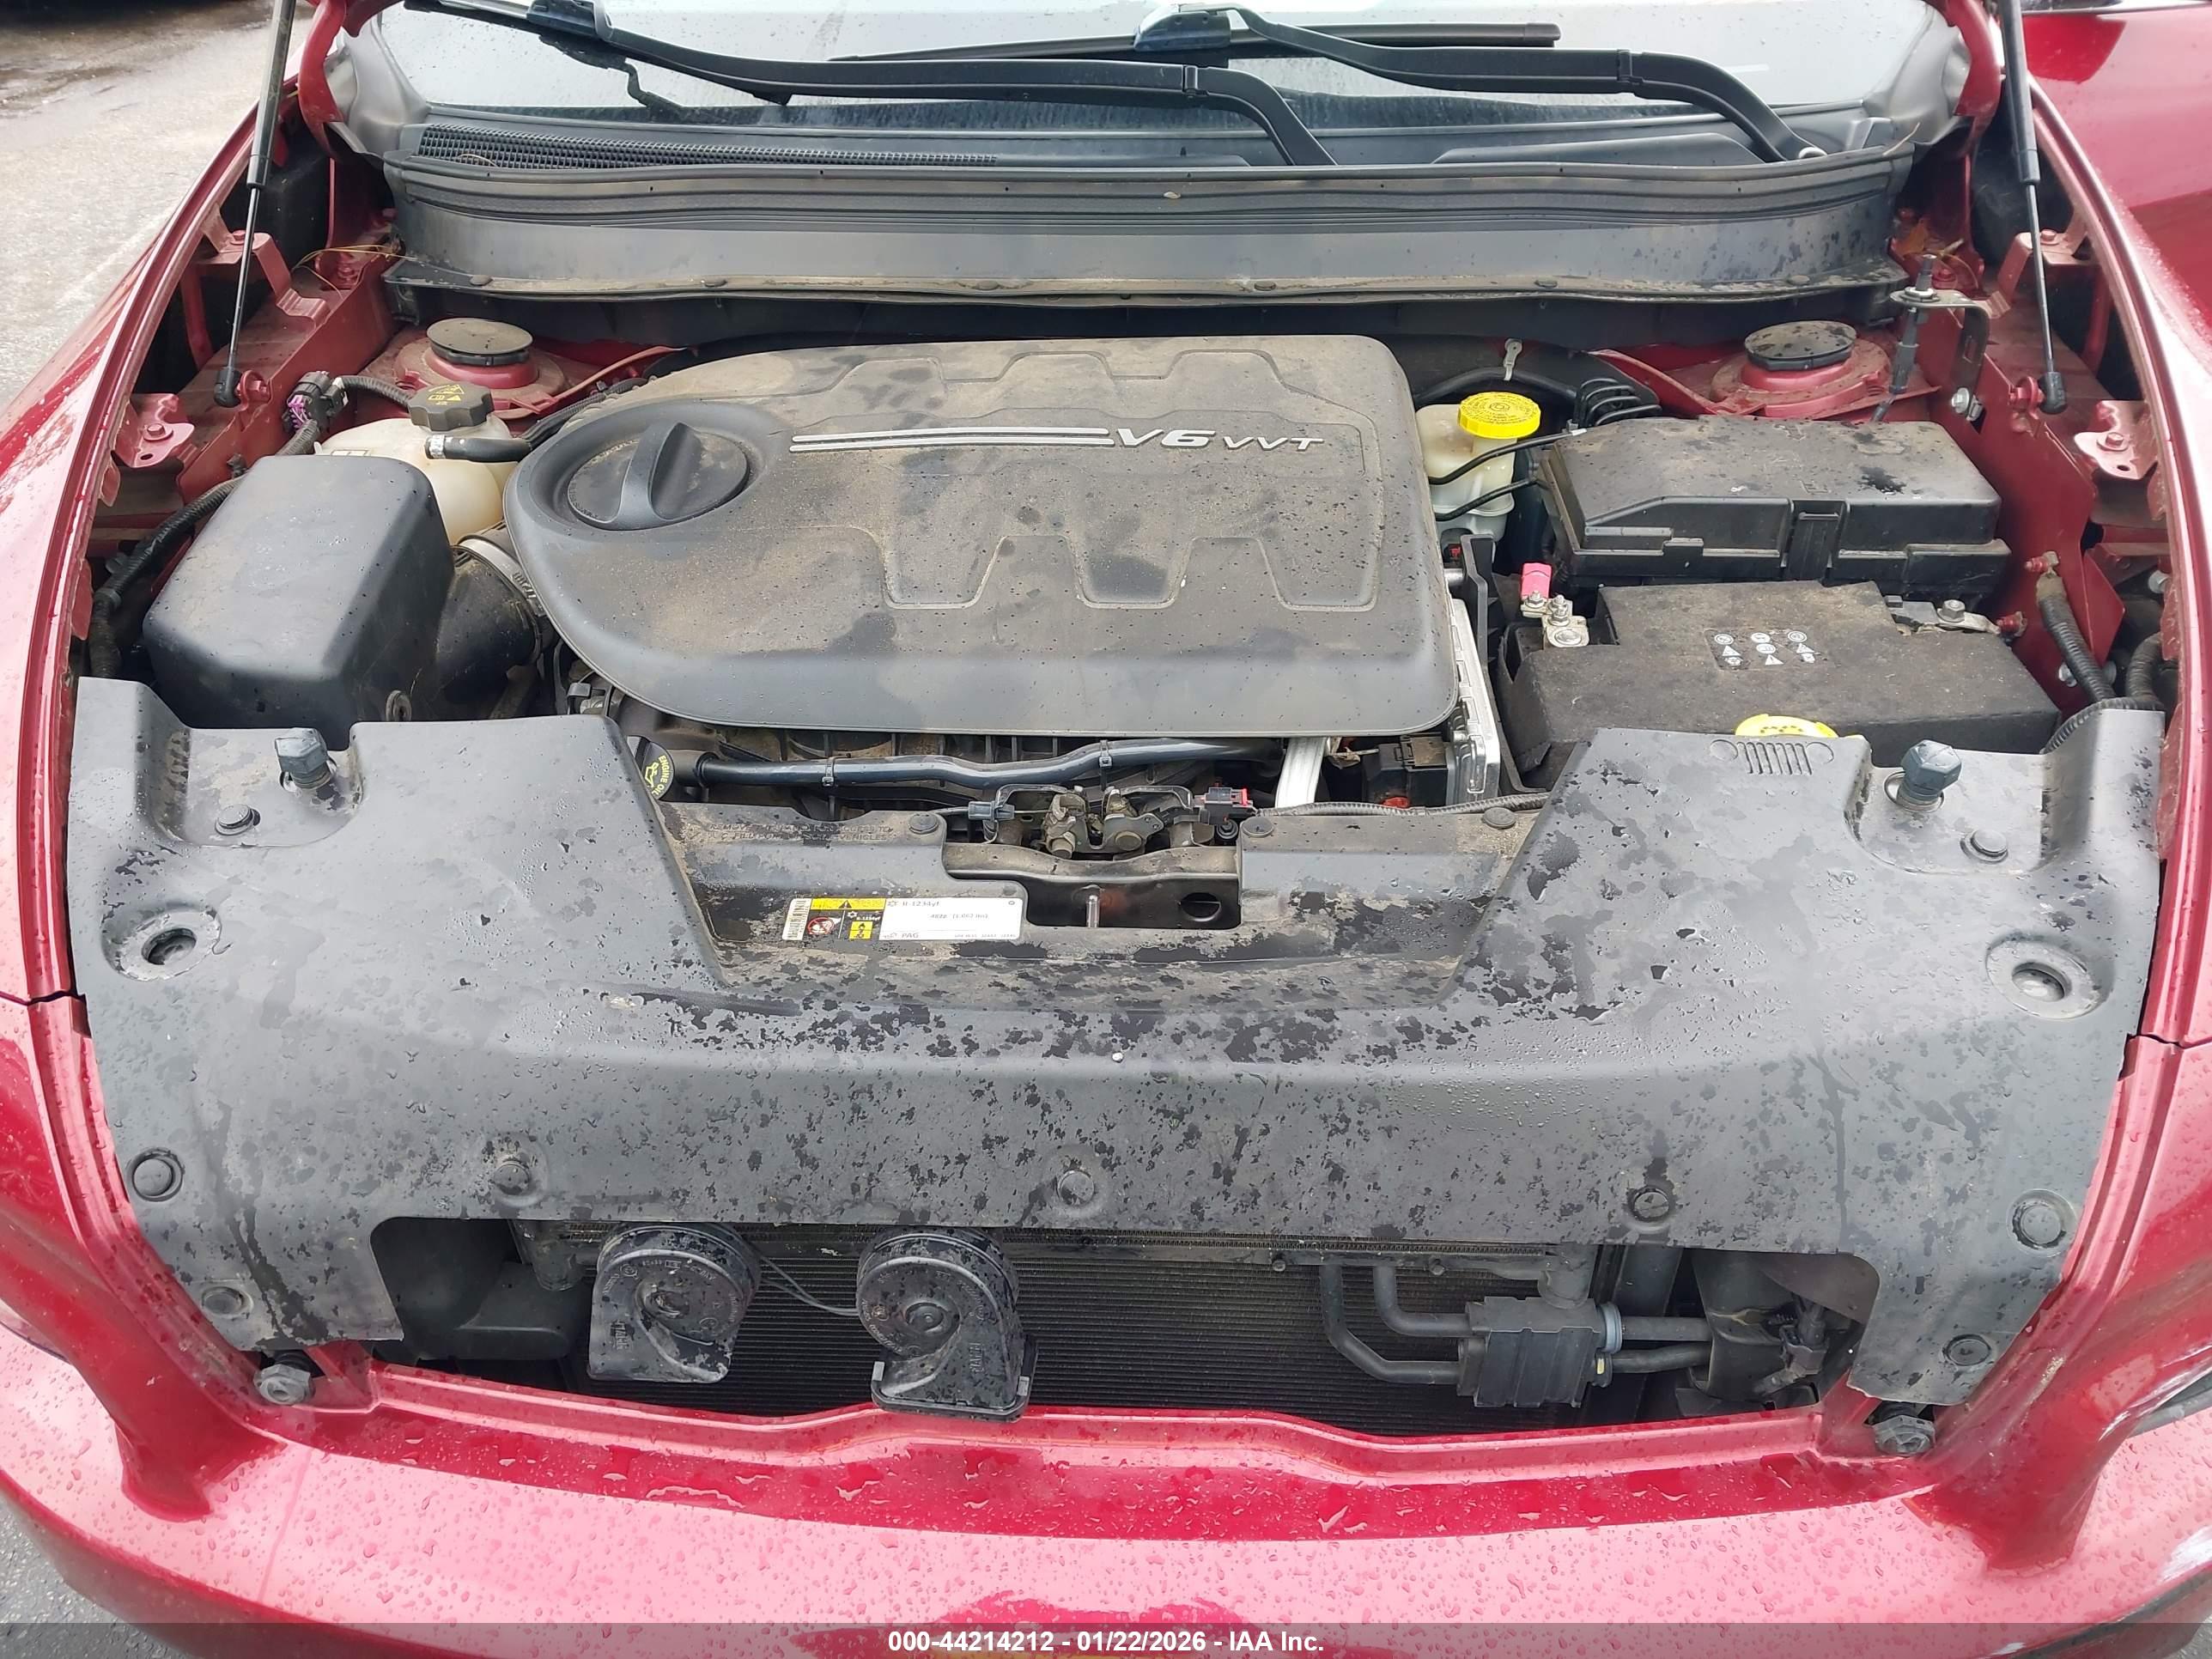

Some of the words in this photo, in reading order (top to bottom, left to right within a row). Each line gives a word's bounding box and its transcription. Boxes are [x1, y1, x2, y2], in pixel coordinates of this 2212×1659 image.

[1117, 428, 1216, 447] V6
[1223, 436, 1325, 451] VVT
[658, 755, 671, 783] ENGINE
[651, 783, 665, 795] OIL
